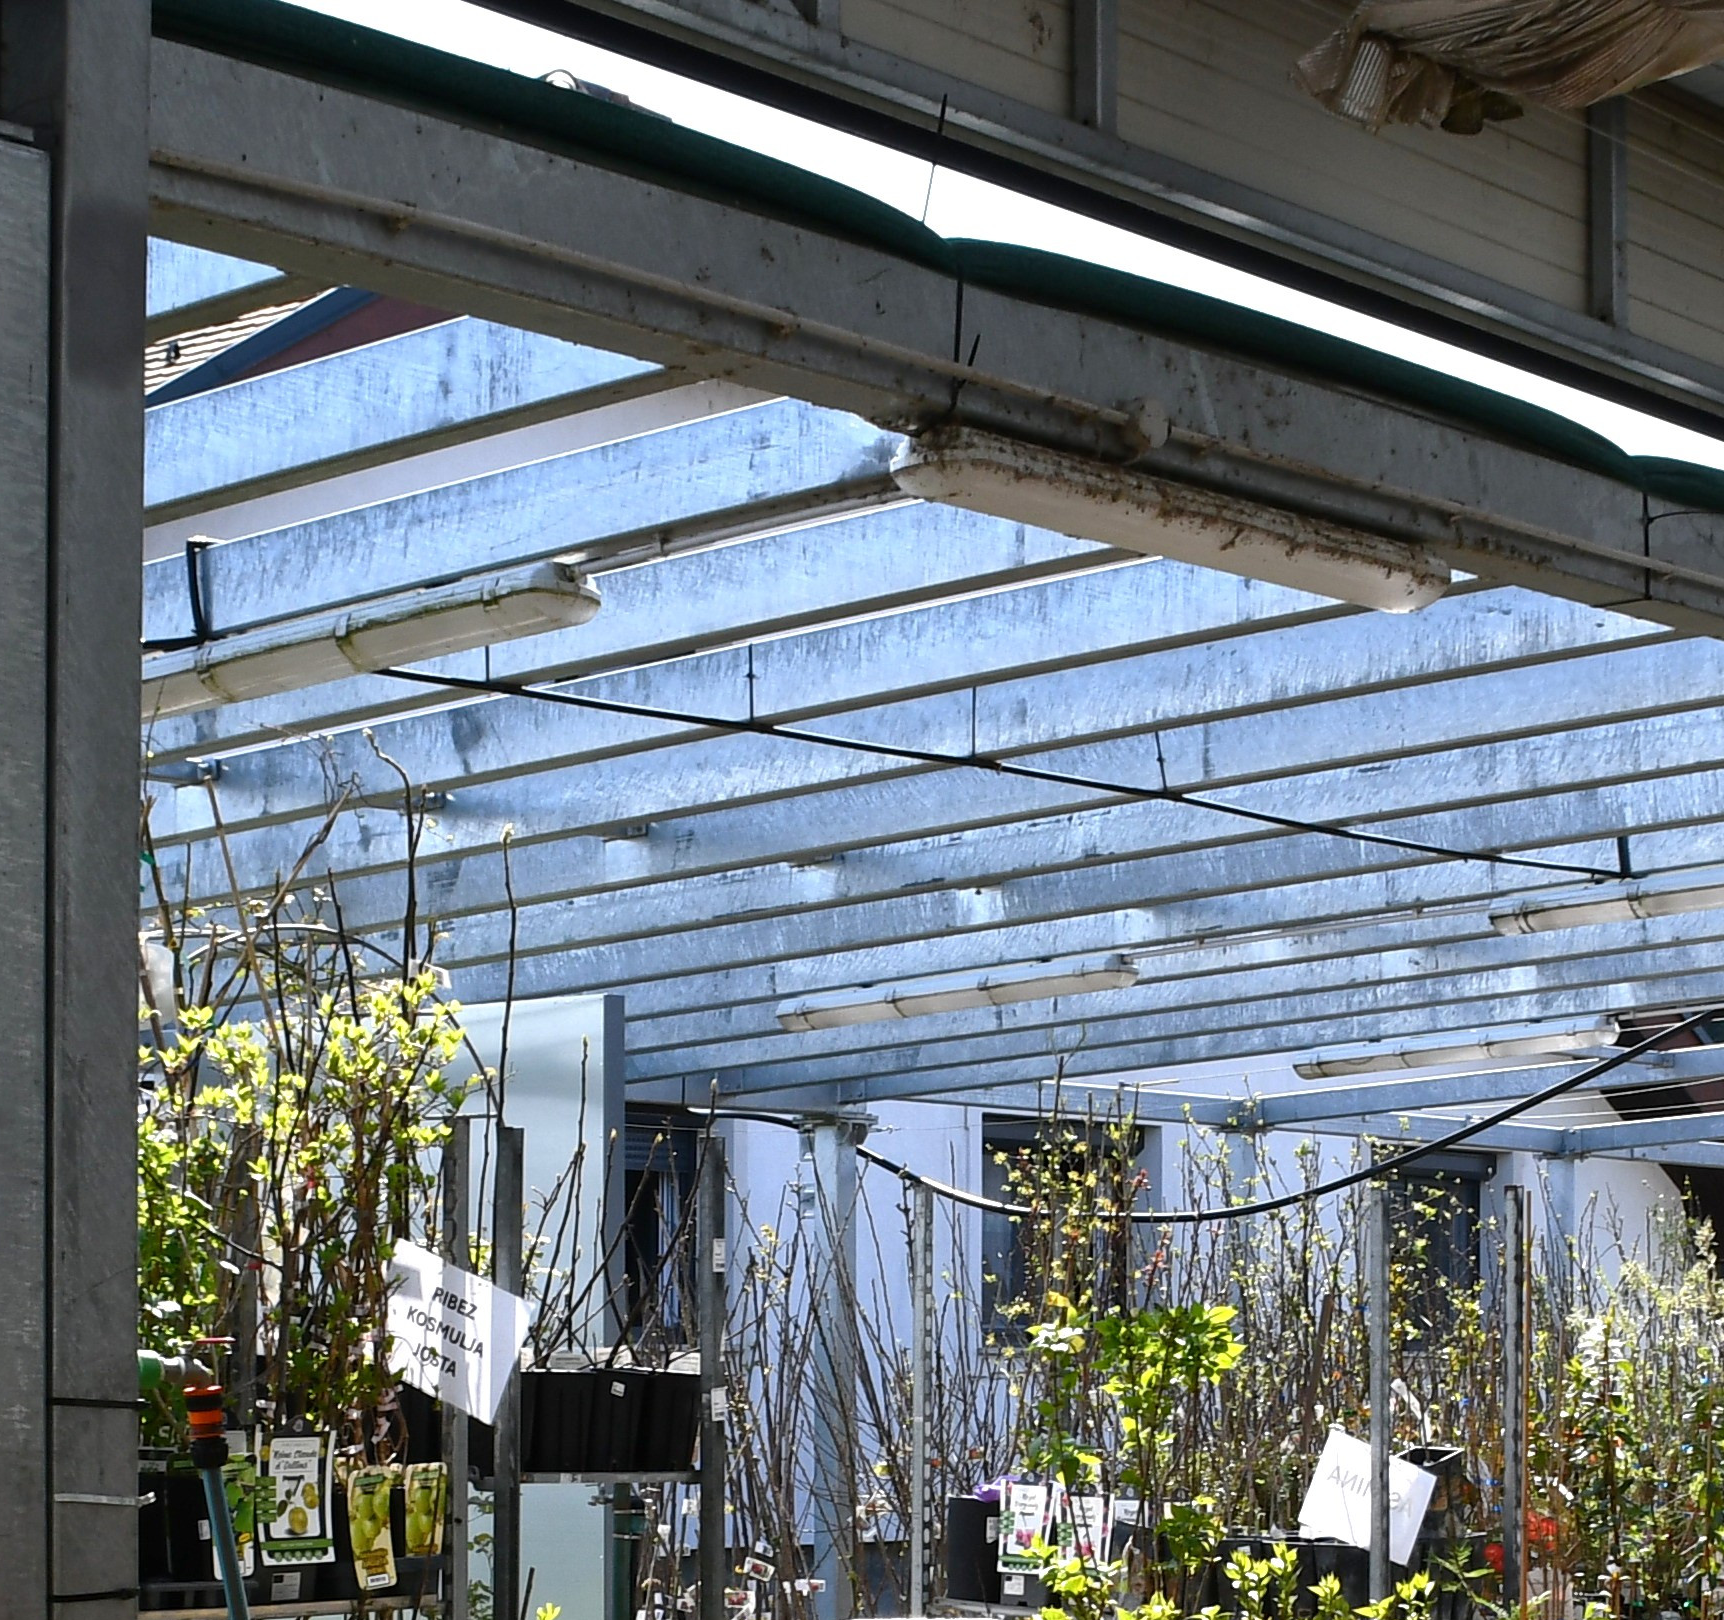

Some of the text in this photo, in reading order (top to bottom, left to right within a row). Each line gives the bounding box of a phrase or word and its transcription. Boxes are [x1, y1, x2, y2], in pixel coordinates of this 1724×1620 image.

[432, 1287, 478, 1321] RIBEZ
[406, 1306, 484, 1359] KOSMULJA
[412, 1342, 457, 1378] JOSTA
